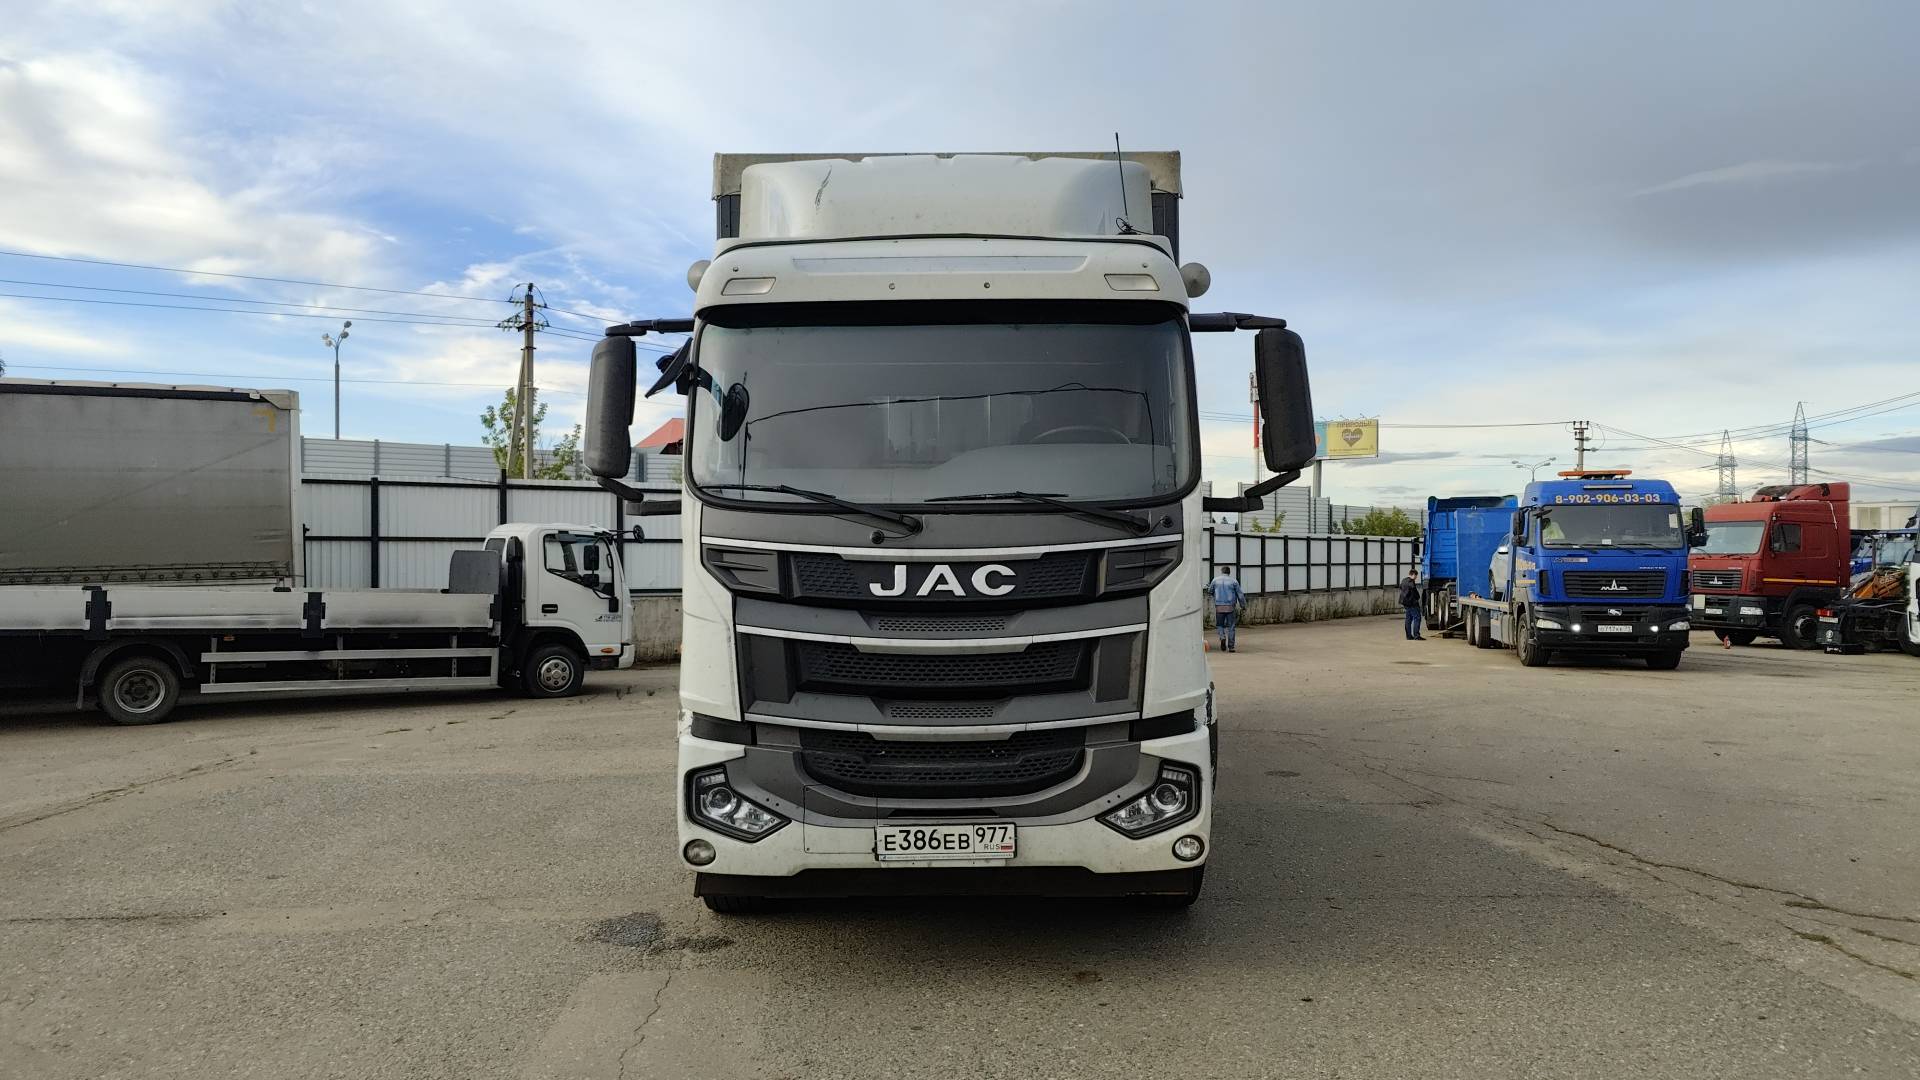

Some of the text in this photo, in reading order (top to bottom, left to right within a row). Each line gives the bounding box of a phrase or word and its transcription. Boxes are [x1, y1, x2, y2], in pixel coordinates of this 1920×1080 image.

[1555, 493, 1660, 504] 8-902-906-03-03
[869, 564, 1016, 597] JAC
[975, 826, 1008, 843] 977
